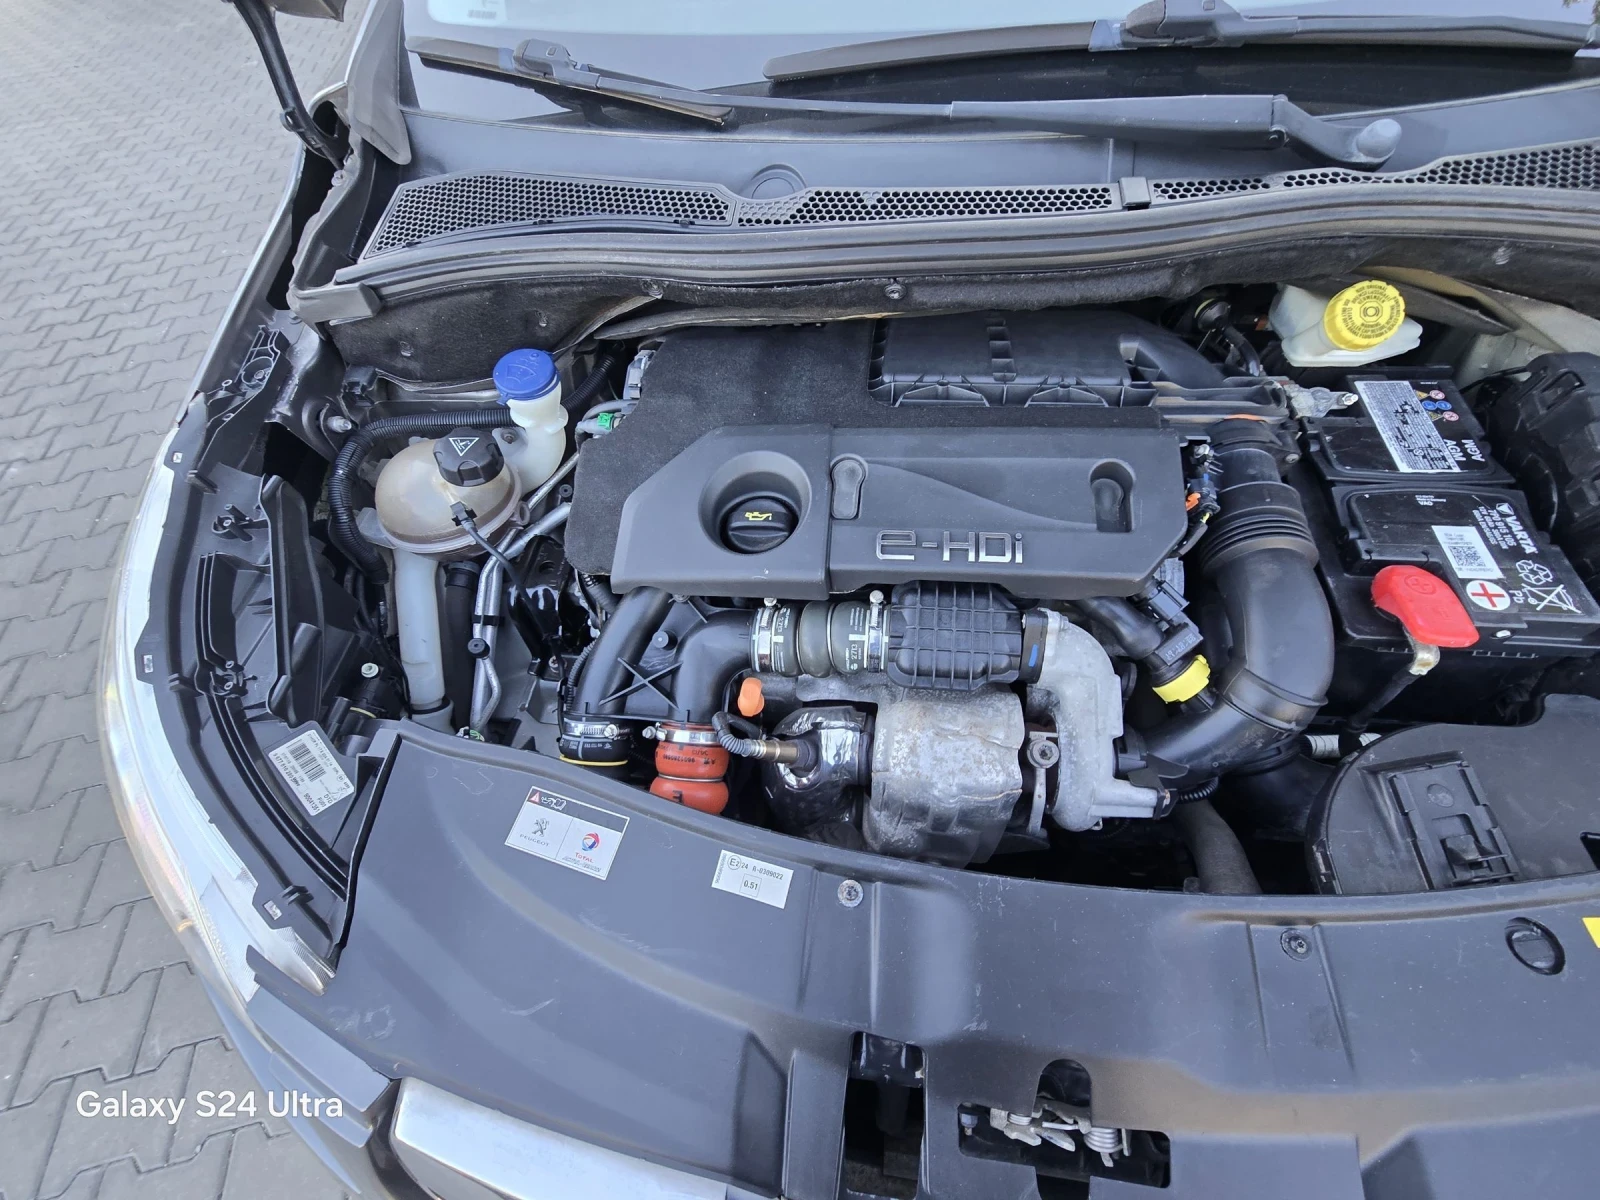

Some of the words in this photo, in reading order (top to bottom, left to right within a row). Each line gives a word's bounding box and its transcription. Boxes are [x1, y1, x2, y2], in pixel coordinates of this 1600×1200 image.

[1444, 439, 1466, 461] AGM
[1462, 439, 1485, 462] AGM
[1502, 534, 1518, 546] 105
[1506, 516, 1538, 554] VARTA
[876, 529, 1023, 563] e-HDi
[1509, 590, 1525, 604] Pb
[520, 834, 550, 847] PEUGEOT
[575, 852, 594, 863] TOTAL
[744, 880, 758, 890] 0.51
